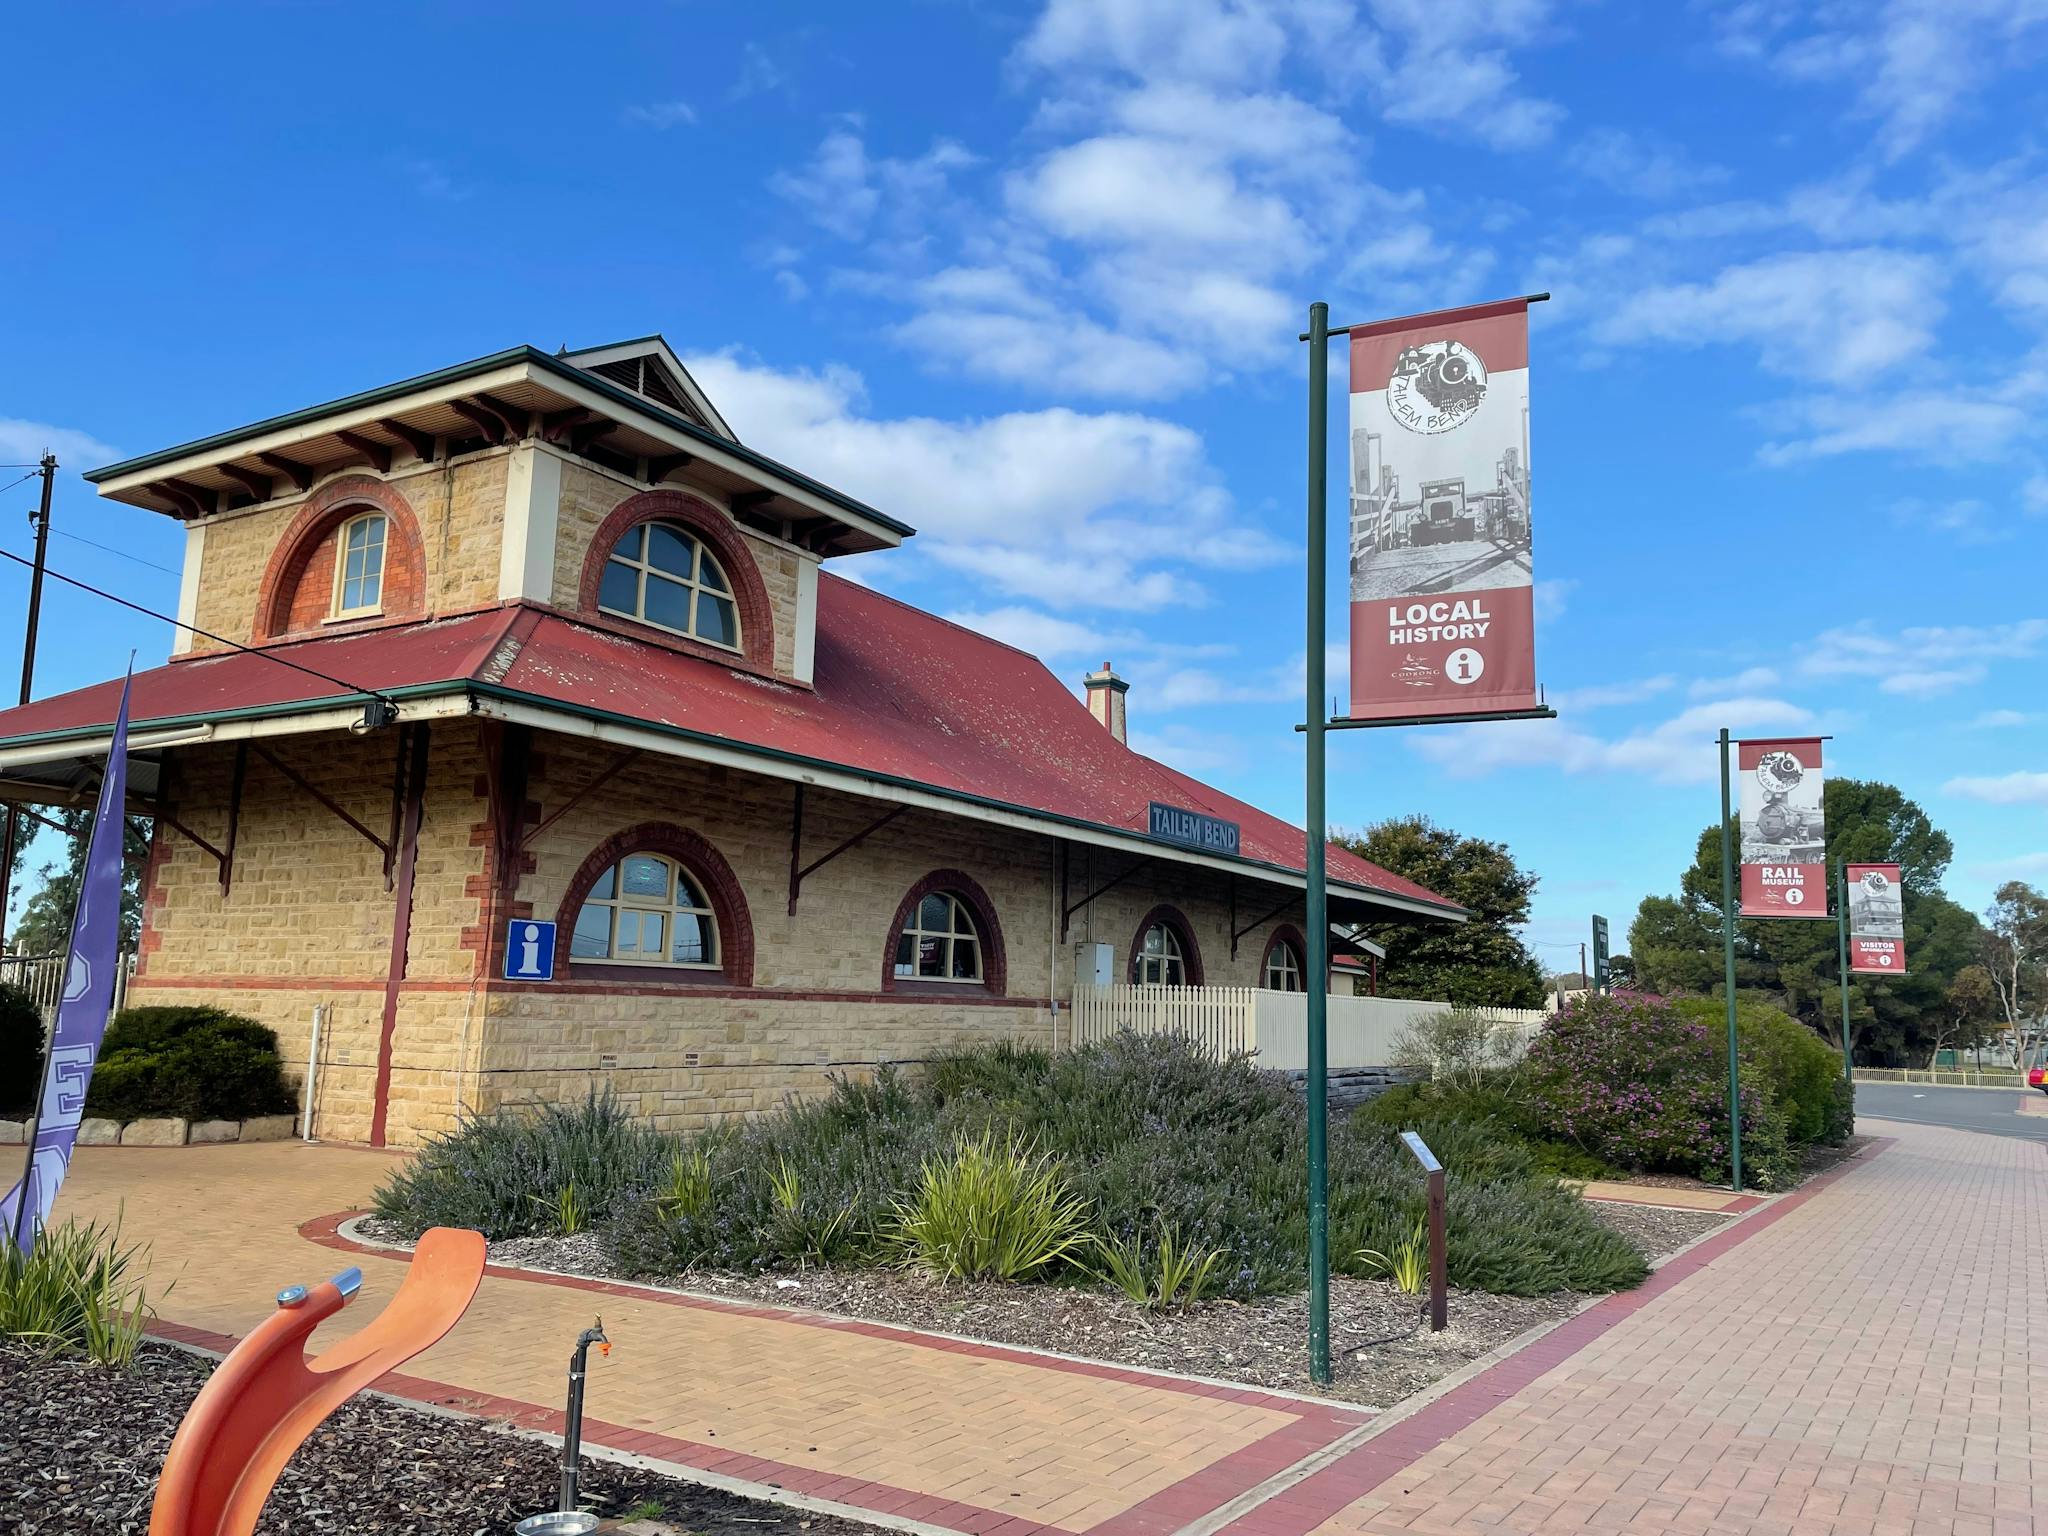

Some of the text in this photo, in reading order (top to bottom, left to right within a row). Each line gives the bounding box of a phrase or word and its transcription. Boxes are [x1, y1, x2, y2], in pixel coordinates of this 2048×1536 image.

[1393, 376, 1467, 428] TAILEM BEND
[1389, 599, 1490, 627] LOCAL
[1389, 622, 1490, 645] HISTORY
[1153, 807, 1236, 849] TAILEM BEND
[1762, 867, 1804, 878] RAIL
